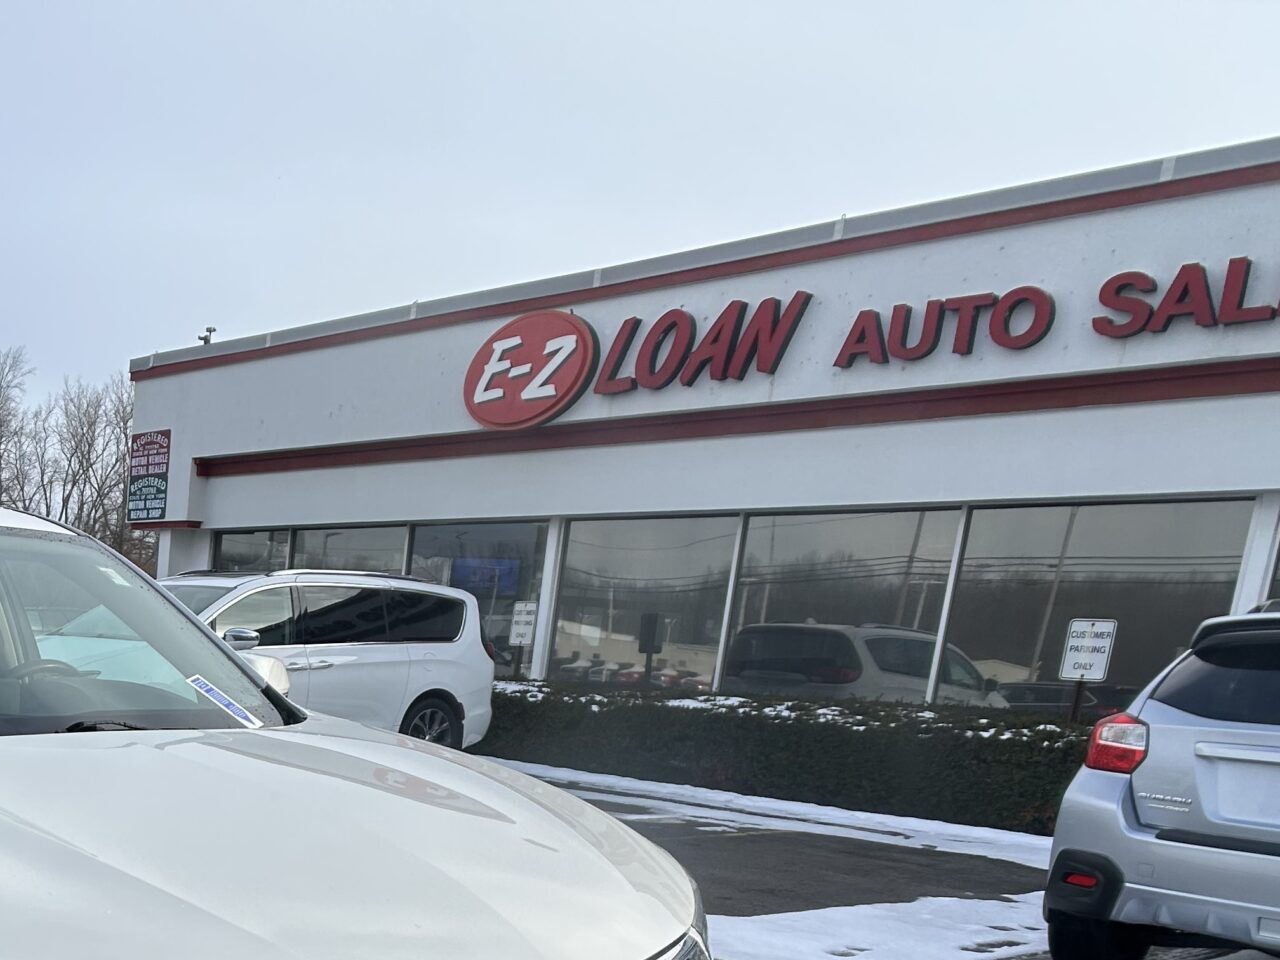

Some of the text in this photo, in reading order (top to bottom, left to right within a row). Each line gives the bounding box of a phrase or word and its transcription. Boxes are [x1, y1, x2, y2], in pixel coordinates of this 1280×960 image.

[473, 256, 1280, 404] E-Z LOAN AUTO SAL
[133, 432, 168, 451] REGISTERED
[130, 477, 166, 493] REGISTERED
[1071, 630, 1112, 640] CUSTOMER
[1069, 645, 1106, 654] PARKING
[1073, 662, 1094, 671] ONLY
